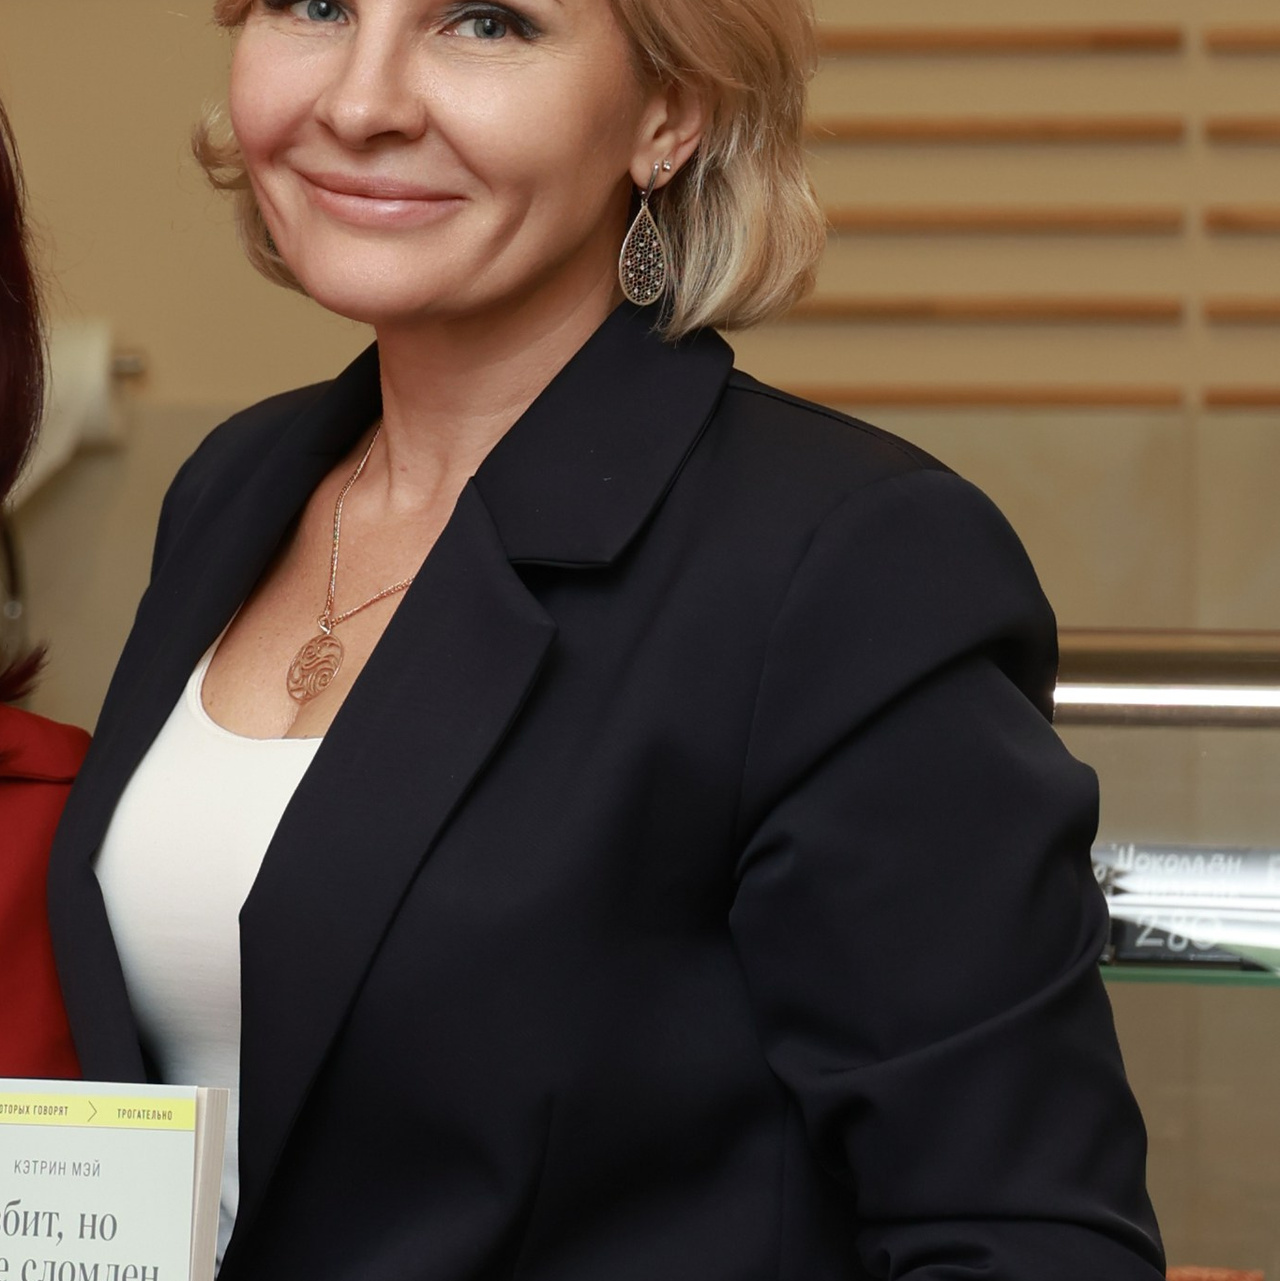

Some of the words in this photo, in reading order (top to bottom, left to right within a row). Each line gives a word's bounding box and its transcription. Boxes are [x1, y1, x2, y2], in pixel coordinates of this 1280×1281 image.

[33, 1104, 69, 1117] ГОВОРЯТ
[116, 1108, 173, 1121] ТРОГАТЕЛЬНО
[13, 1159, 67, 1176] КЭТРИН
[71, 1159, 101, 1178] МЭЙ
[78, 1212, 118, 1242] но
